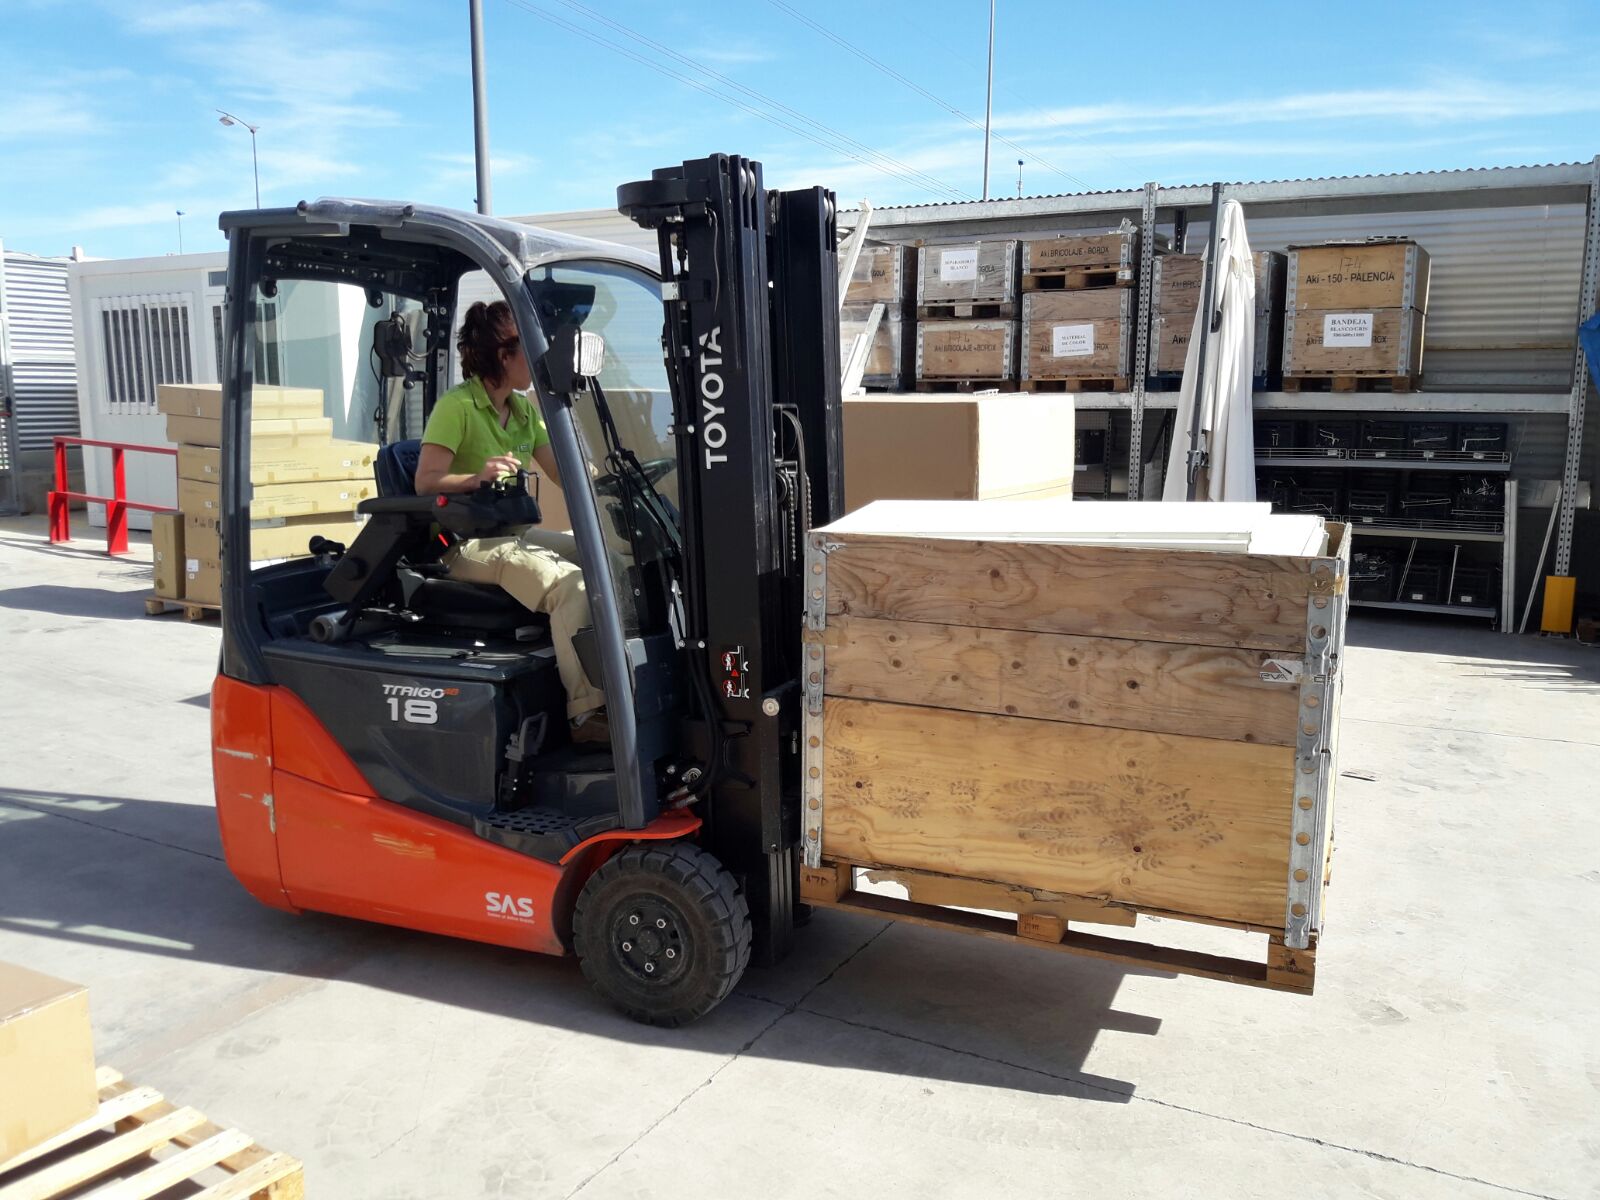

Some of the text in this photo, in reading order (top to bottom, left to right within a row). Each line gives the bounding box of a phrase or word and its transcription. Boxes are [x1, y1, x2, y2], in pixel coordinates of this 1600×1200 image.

[1328, 273, 1343, 283] 150
[1350, 271, 1395, 282] PALENCIA
[699, 326, 728, 470] TOYOTA
[386, 697, 439, 725] 18
[484, 891, 535, 918] SAS
